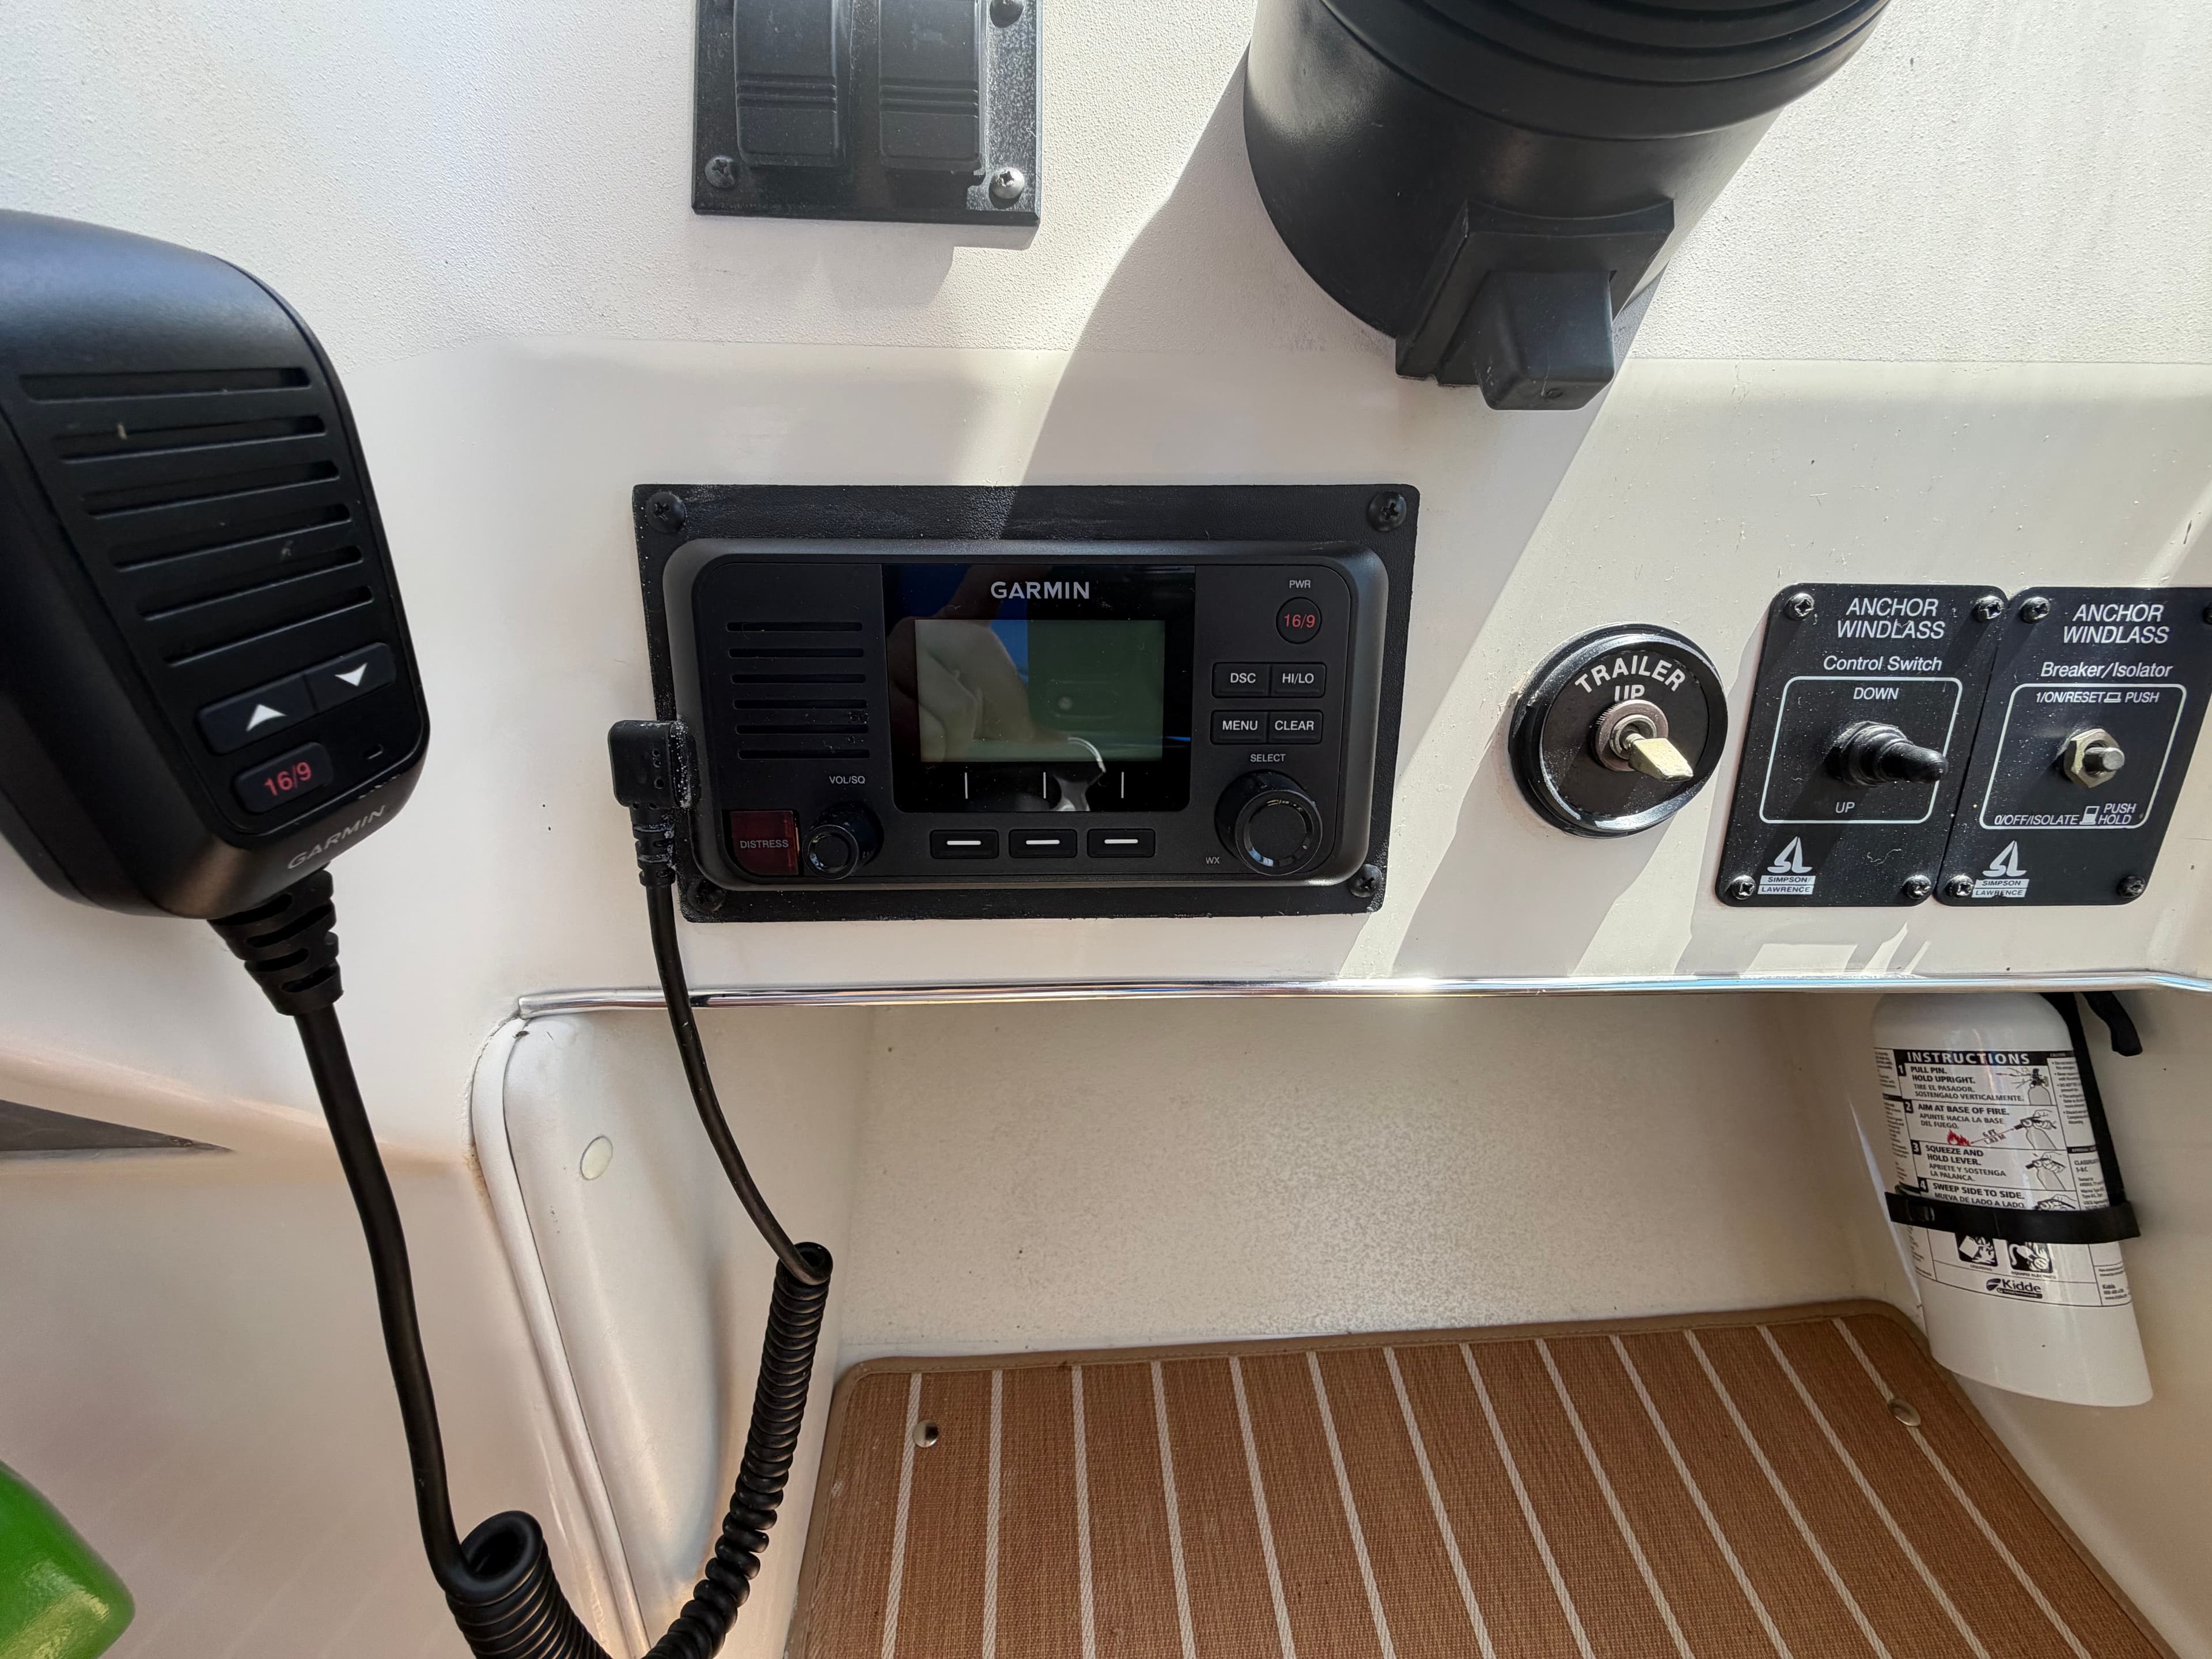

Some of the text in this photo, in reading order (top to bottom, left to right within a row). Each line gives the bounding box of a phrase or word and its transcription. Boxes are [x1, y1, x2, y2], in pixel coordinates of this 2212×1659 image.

[990, 581, 1090, 599] GARMIN
[1289, 579, 1311, 589] PWR
[1846, 598, 1940, 616] ANCHOR
[2073, 604, 2165, 622] ANCHOR
[1283, 614, 1316, 628] 16/9
[1837, 620, 1946, 639] WINDLASS
[2063, 626, 2169, 644] WINDLASS
[1823, 656, 1943, 672] Control Switch
[2040, 662, 2173, 678] Breaker/Isolator
[1230, 673, 1256, 683] DSC
[1282, 673, 1315, 684] HI/LO
[1574, 654, 1685, 694] TRAILER
[1613, 684, 1645, 702] UP
[1853, 687, 1899, 700] DOWN
[2036, 692, 2160, 704] 1/ON/RESET PUSH
[1222, 720, 1258, 730] MENU
[1274, 720, 1315, 730] CLEAR
[1250, 753, 1286, 762] SELECT
[263, 761, 312, 796] 16/9
[828, 775, 865, 784] VOL/SQ
[1835, 801, 1855, 813] UP
[2103, 803, 2137, 814] PUSH
[1994, 815, 2080, 825] 0/OFF/ISOLATE
[2097, 815, 2132, 825] HOLD
[286, 805, 386, 870] GARMIN
[740, 839, 789, 849] DISTRESS
[1907, 1051, 2030, 1065] INSTRUCTIONS
[1898, 1065, 1904, 1074] 1
[1936, 1076, 1975, 1084] UPRIGHT.
[1905, 1103, 1912, 1112] 2
[1934, 1121, 1959, 1129] FUEGO.
[1912, 1142, 1919, 1150] 3
[1926, 1145, 1961, 1155] SQUEEZE
[1927, 1154, 1982, 1166] HOLD LEVER.
[1929, 1163, 1956, 1172] APRIETE
[1964, 1167, 2007, 1176] SOSTENGA
[1940, 1172, 1975, 1181] PALANCA.
[1919, 1181, 1925, 1189] 4
[1933, 1183, 2025, 1199] SWEEP SIDE TO SIDE.
[1934, 1192, 1958, 1202] MUEVA
[1971, 1198, 1993, 1206] LADO
[2001, 1278, 2041, 1293] Kidde
